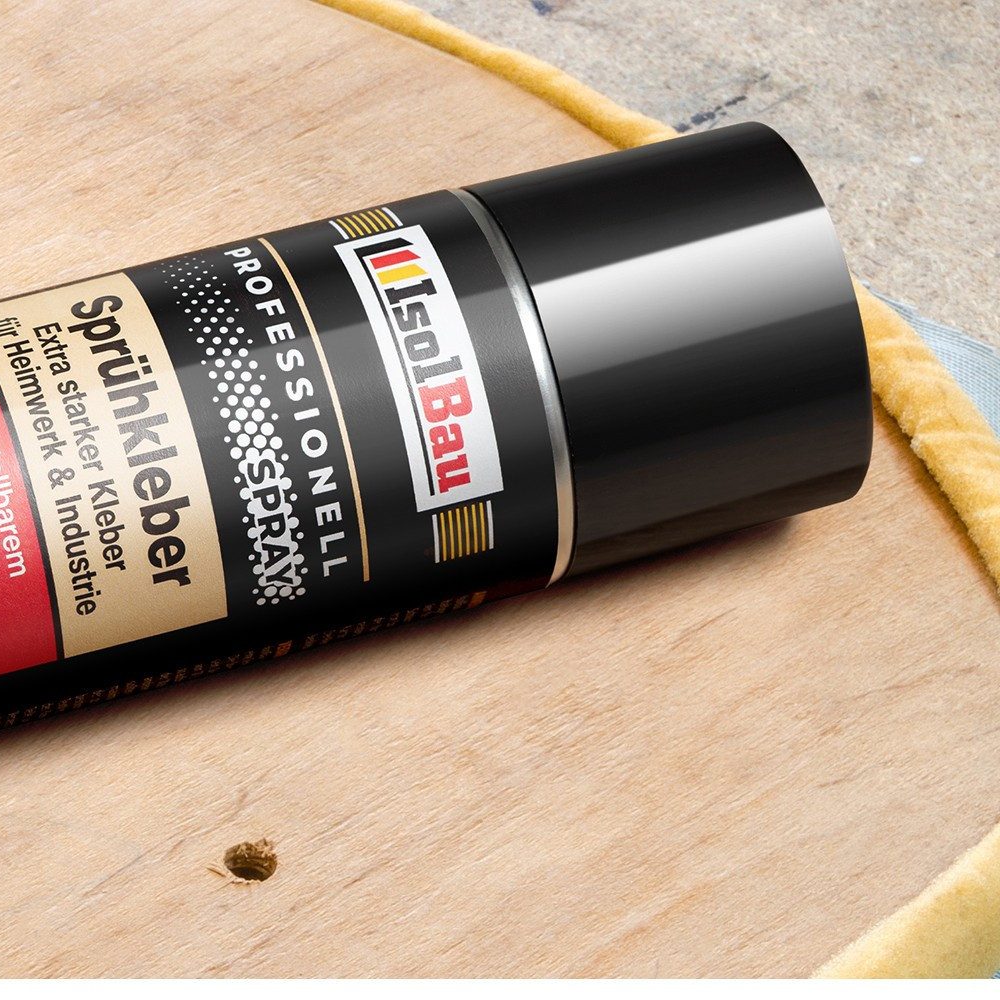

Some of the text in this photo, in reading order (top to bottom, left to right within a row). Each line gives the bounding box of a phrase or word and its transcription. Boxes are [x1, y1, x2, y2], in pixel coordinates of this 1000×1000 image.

[3, 339, 67, 461] Heimwerk
[33, 322, 126, 571] Extra starker Kleber
[67, 295, 191, 587] Sprühkleber
[224, 246, 348, 577] PROFESSIONELL
[384, 278, 473, 494] IsolBau
[47, 467, 76, 490] &
[55, 494, 101, 616] Industrie
[247, 458, 294, 585] SPRAY
